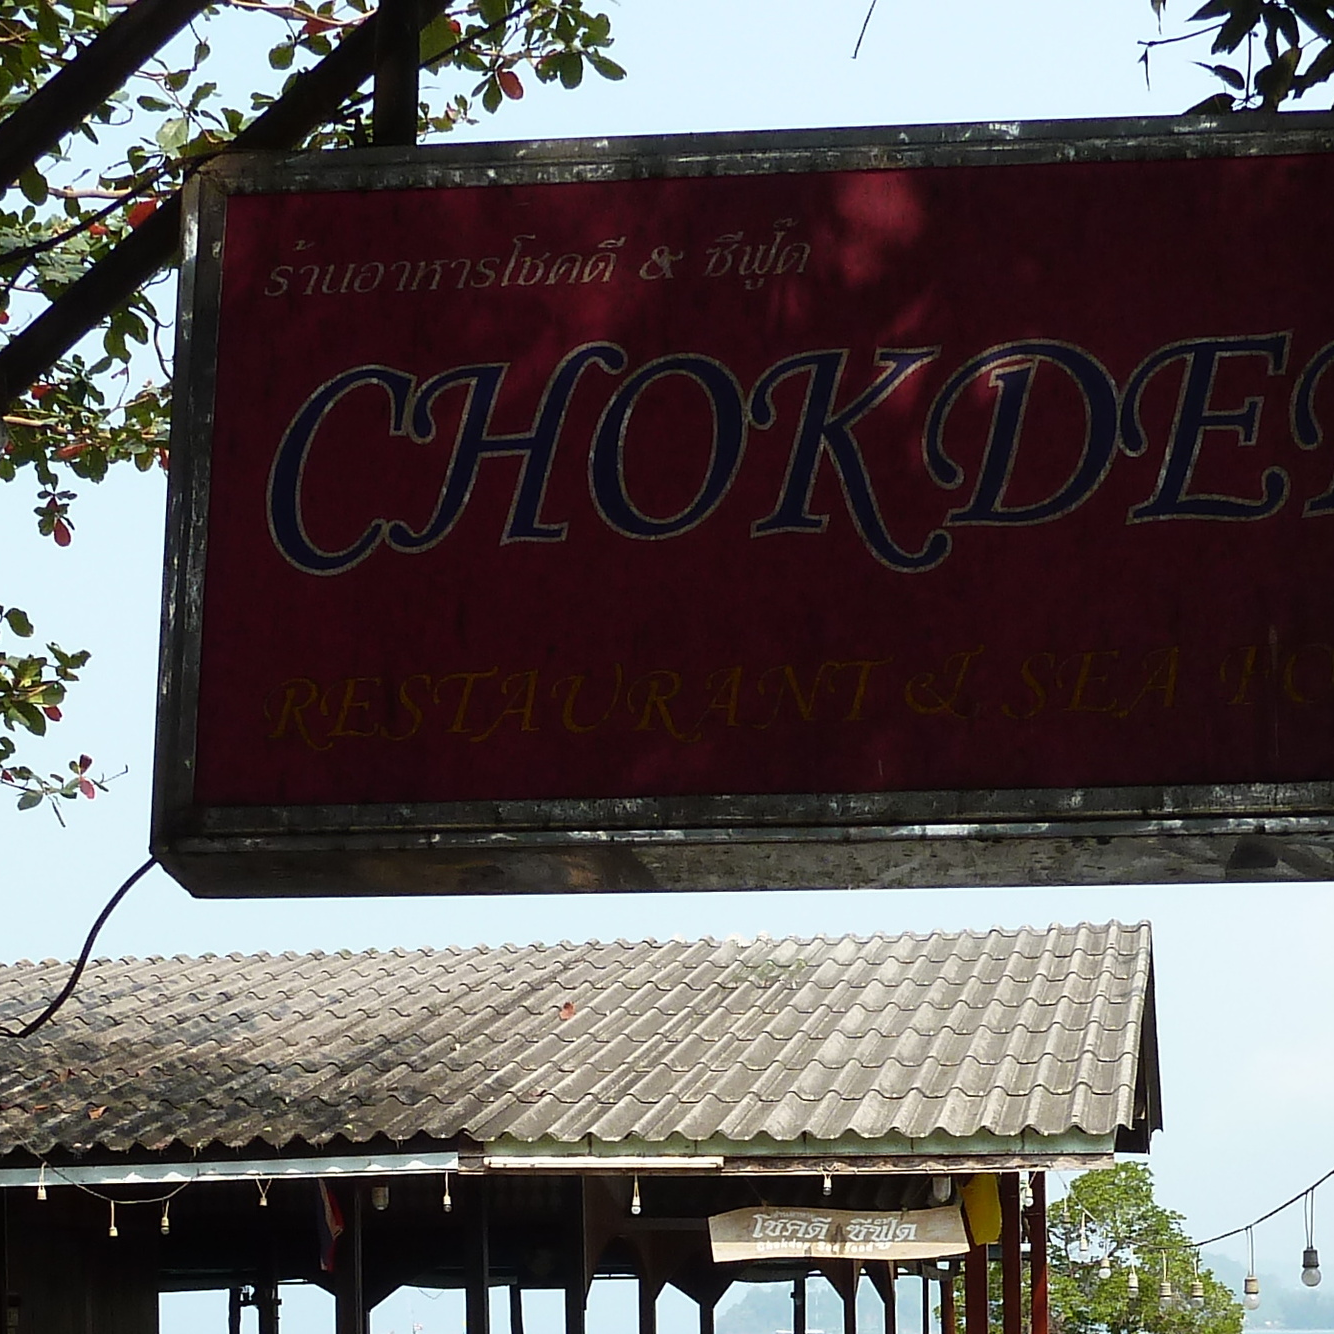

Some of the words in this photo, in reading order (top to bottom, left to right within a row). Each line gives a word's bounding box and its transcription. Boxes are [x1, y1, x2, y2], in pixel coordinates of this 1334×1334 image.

[264, 235, 626, 298] ร้านอาหารโชคดี
[639, 244, 685, 281] &
[264, 652, 894, 751] RESTAURANT
[903, 644, 985, 720] &
[1002, 644, 1185, 724] SEA
[752, 1213, 832, 1240] โชคดี
